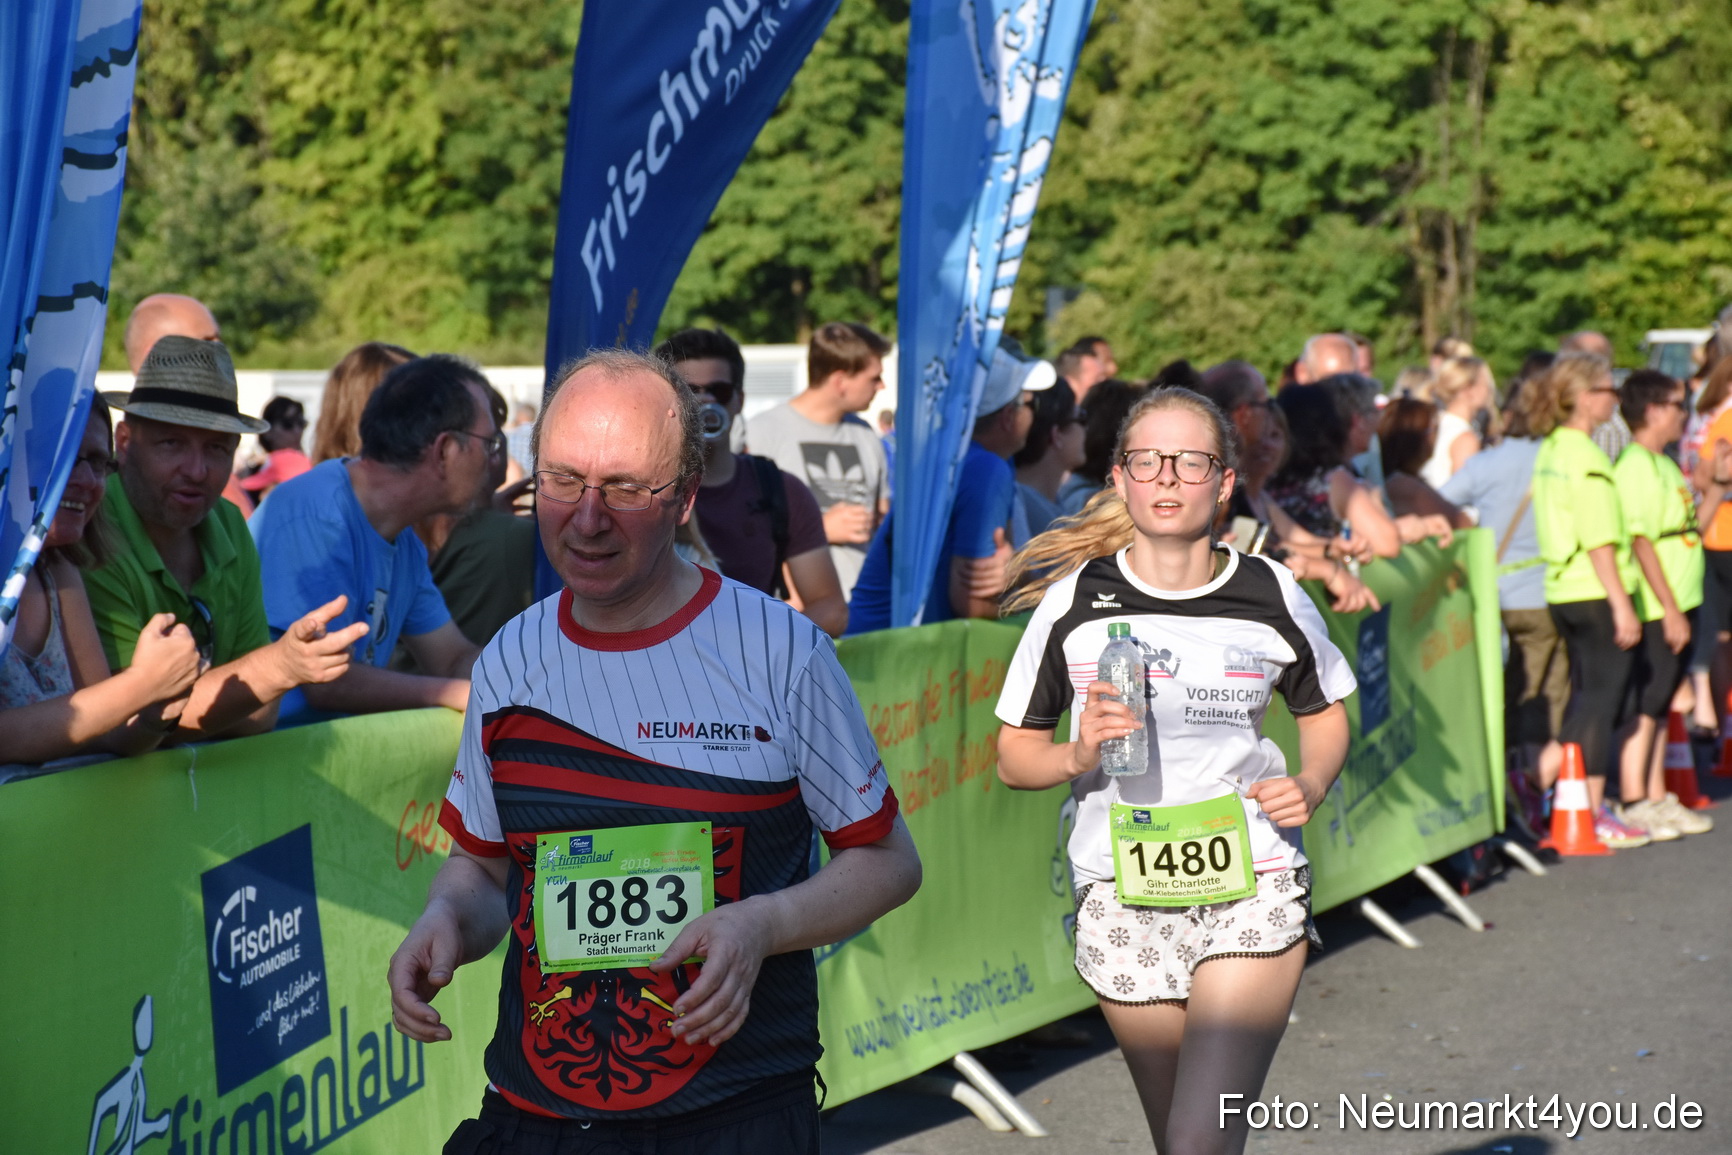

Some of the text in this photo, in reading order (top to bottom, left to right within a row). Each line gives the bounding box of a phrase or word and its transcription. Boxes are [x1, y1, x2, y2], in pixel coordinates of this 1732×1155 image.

[1186, 687, 1265, 703] VORSICHT!
[638, 722, 749, 741] NEUMARKT
[1126, 822, 1170, 832] firmenlauf
[1177, 827, 1203, 837] 2018
[558, 850, 614, 866] firmenlauf
[621, 858, 650, 870] 2018
[1129, 836, 1231, 877] 1480
[1147, 876, 1221, 889] Gihr Charlotte
[1143, 885, 1227, 897] OM-Klebetechnik GmbH
[556, 874, 688, 931] 1883
[230, 906, 302, 969] Fischer
[579, 929, 665, 947] Präger Frank
[586, 944, 656, 956] Stadt Neumarkt
[240, 943, 301, 989] AUTOMOBILE
